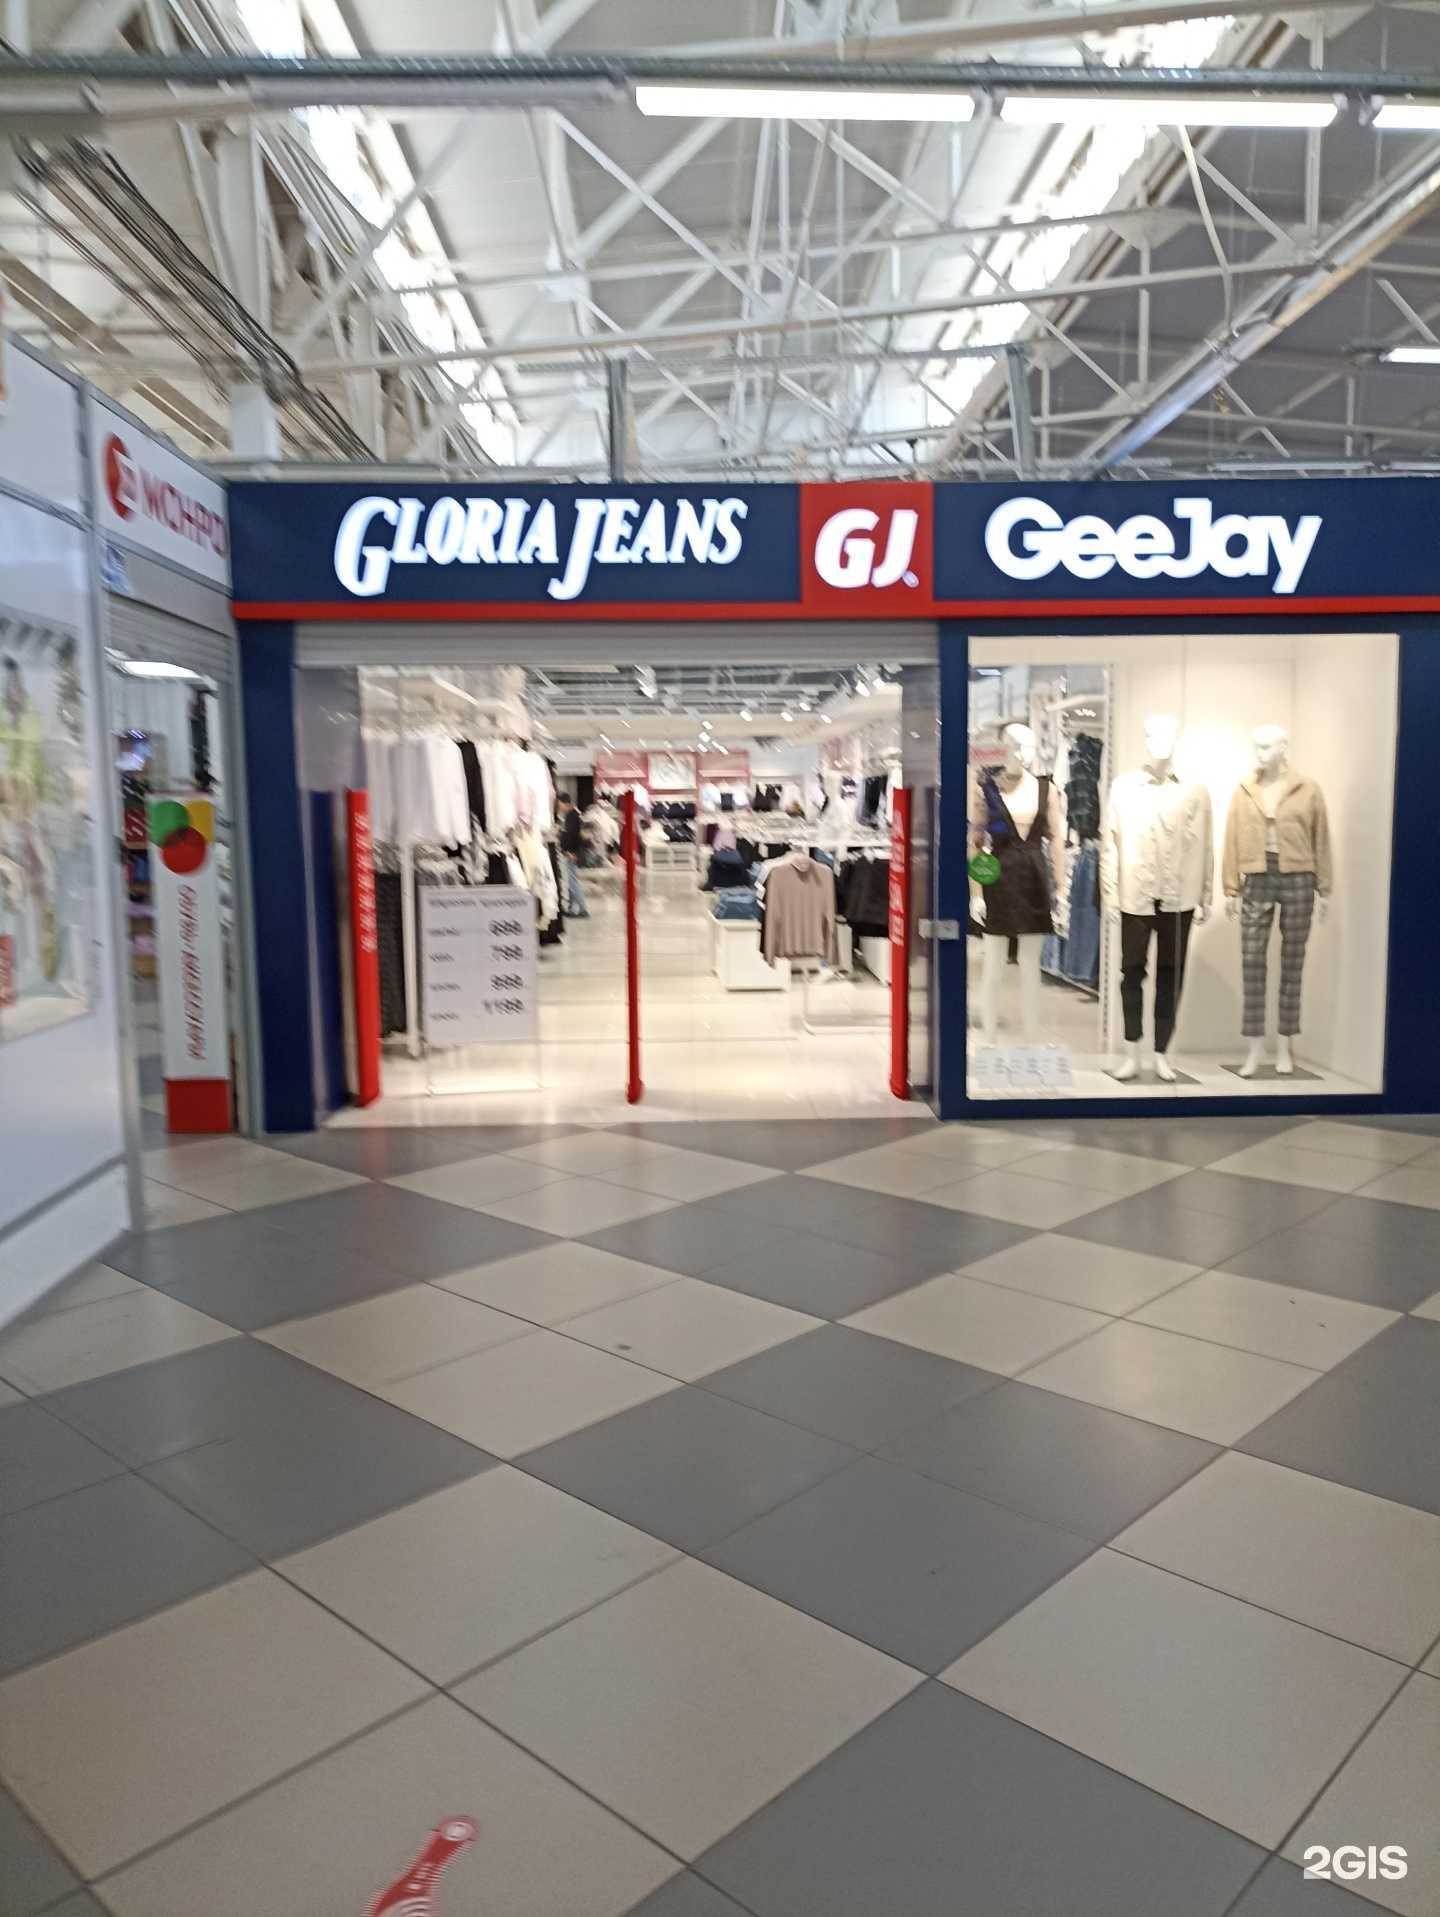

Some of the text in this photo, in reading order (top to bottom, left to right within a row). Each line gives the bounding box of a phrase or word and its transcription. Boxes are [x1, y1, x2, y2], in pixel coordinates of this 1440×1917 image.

[333, 496, 748, 600] GLORIA JEANS
[814, 508, 919, 588] GJ
[985, 497, 1323, 594] GeeJay
